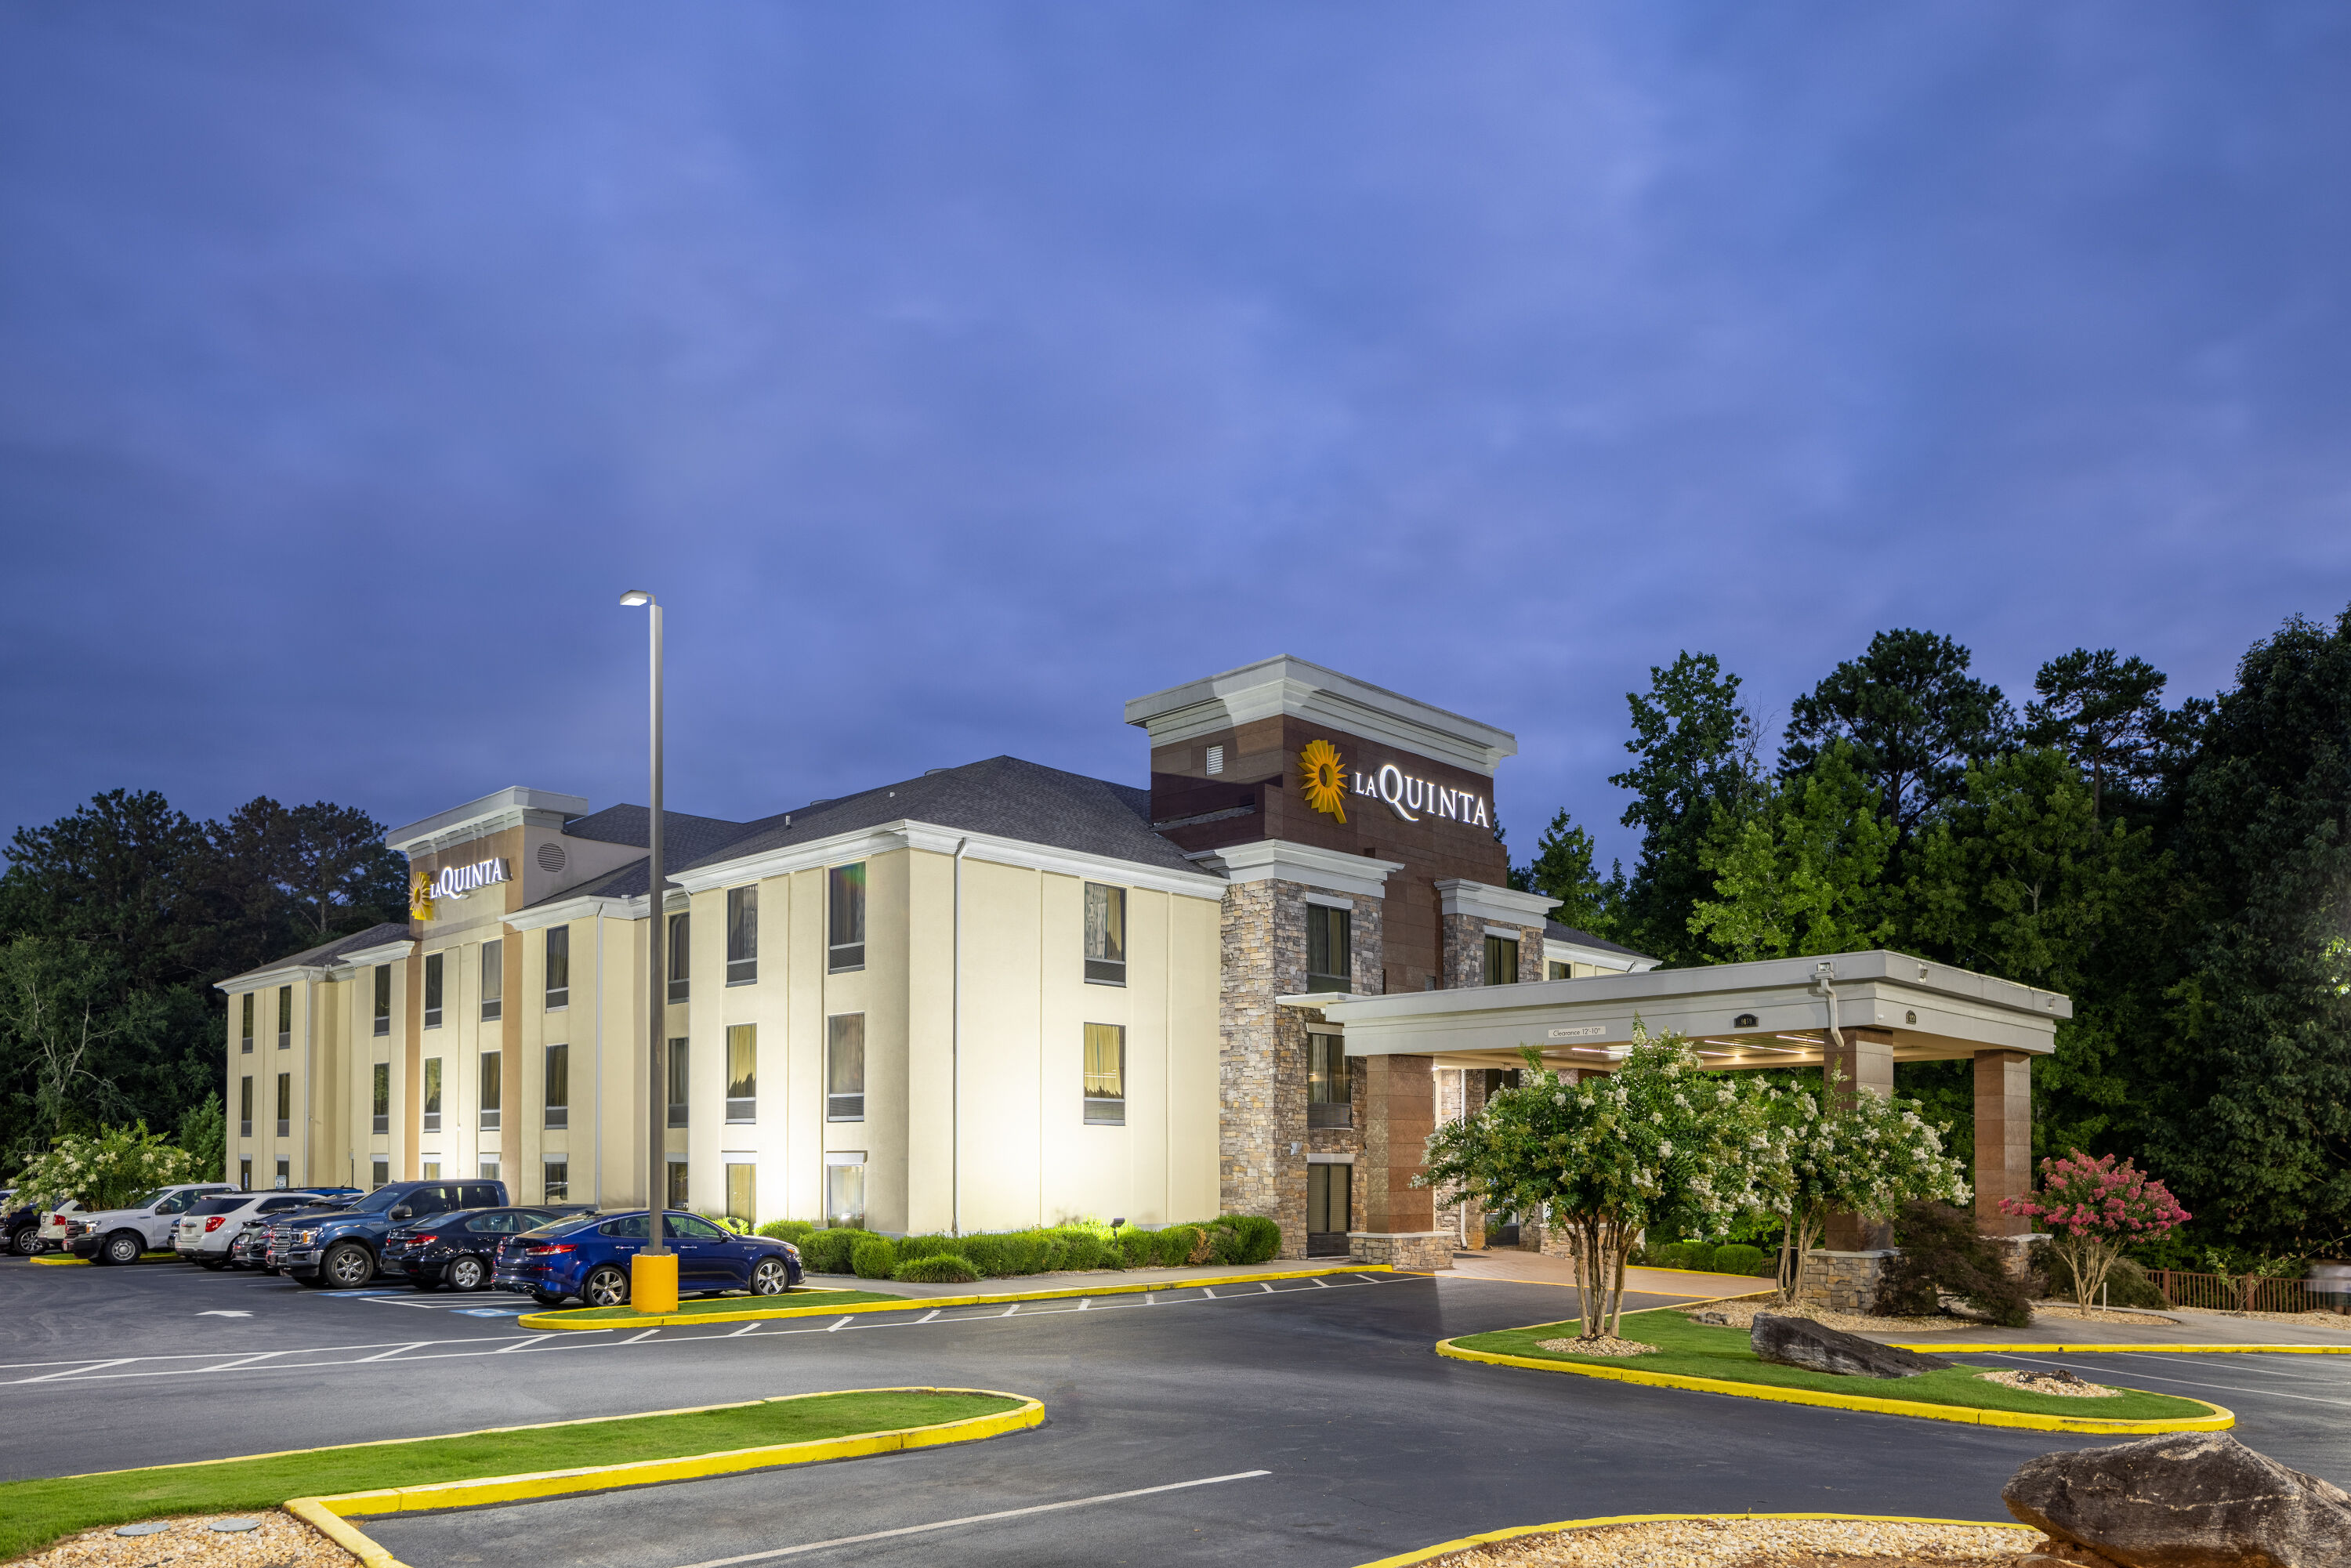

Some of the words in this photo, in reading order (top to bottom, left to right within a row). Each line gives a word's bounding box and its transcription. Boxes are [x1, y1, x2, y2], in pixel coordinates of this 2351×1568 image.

[1354, 772, 1378, 798] LA
[1379, 764, 1490, 828] QUINTA
[430, 882, 442, 900] LA
[440, 856, 503, 900] QUINTA
